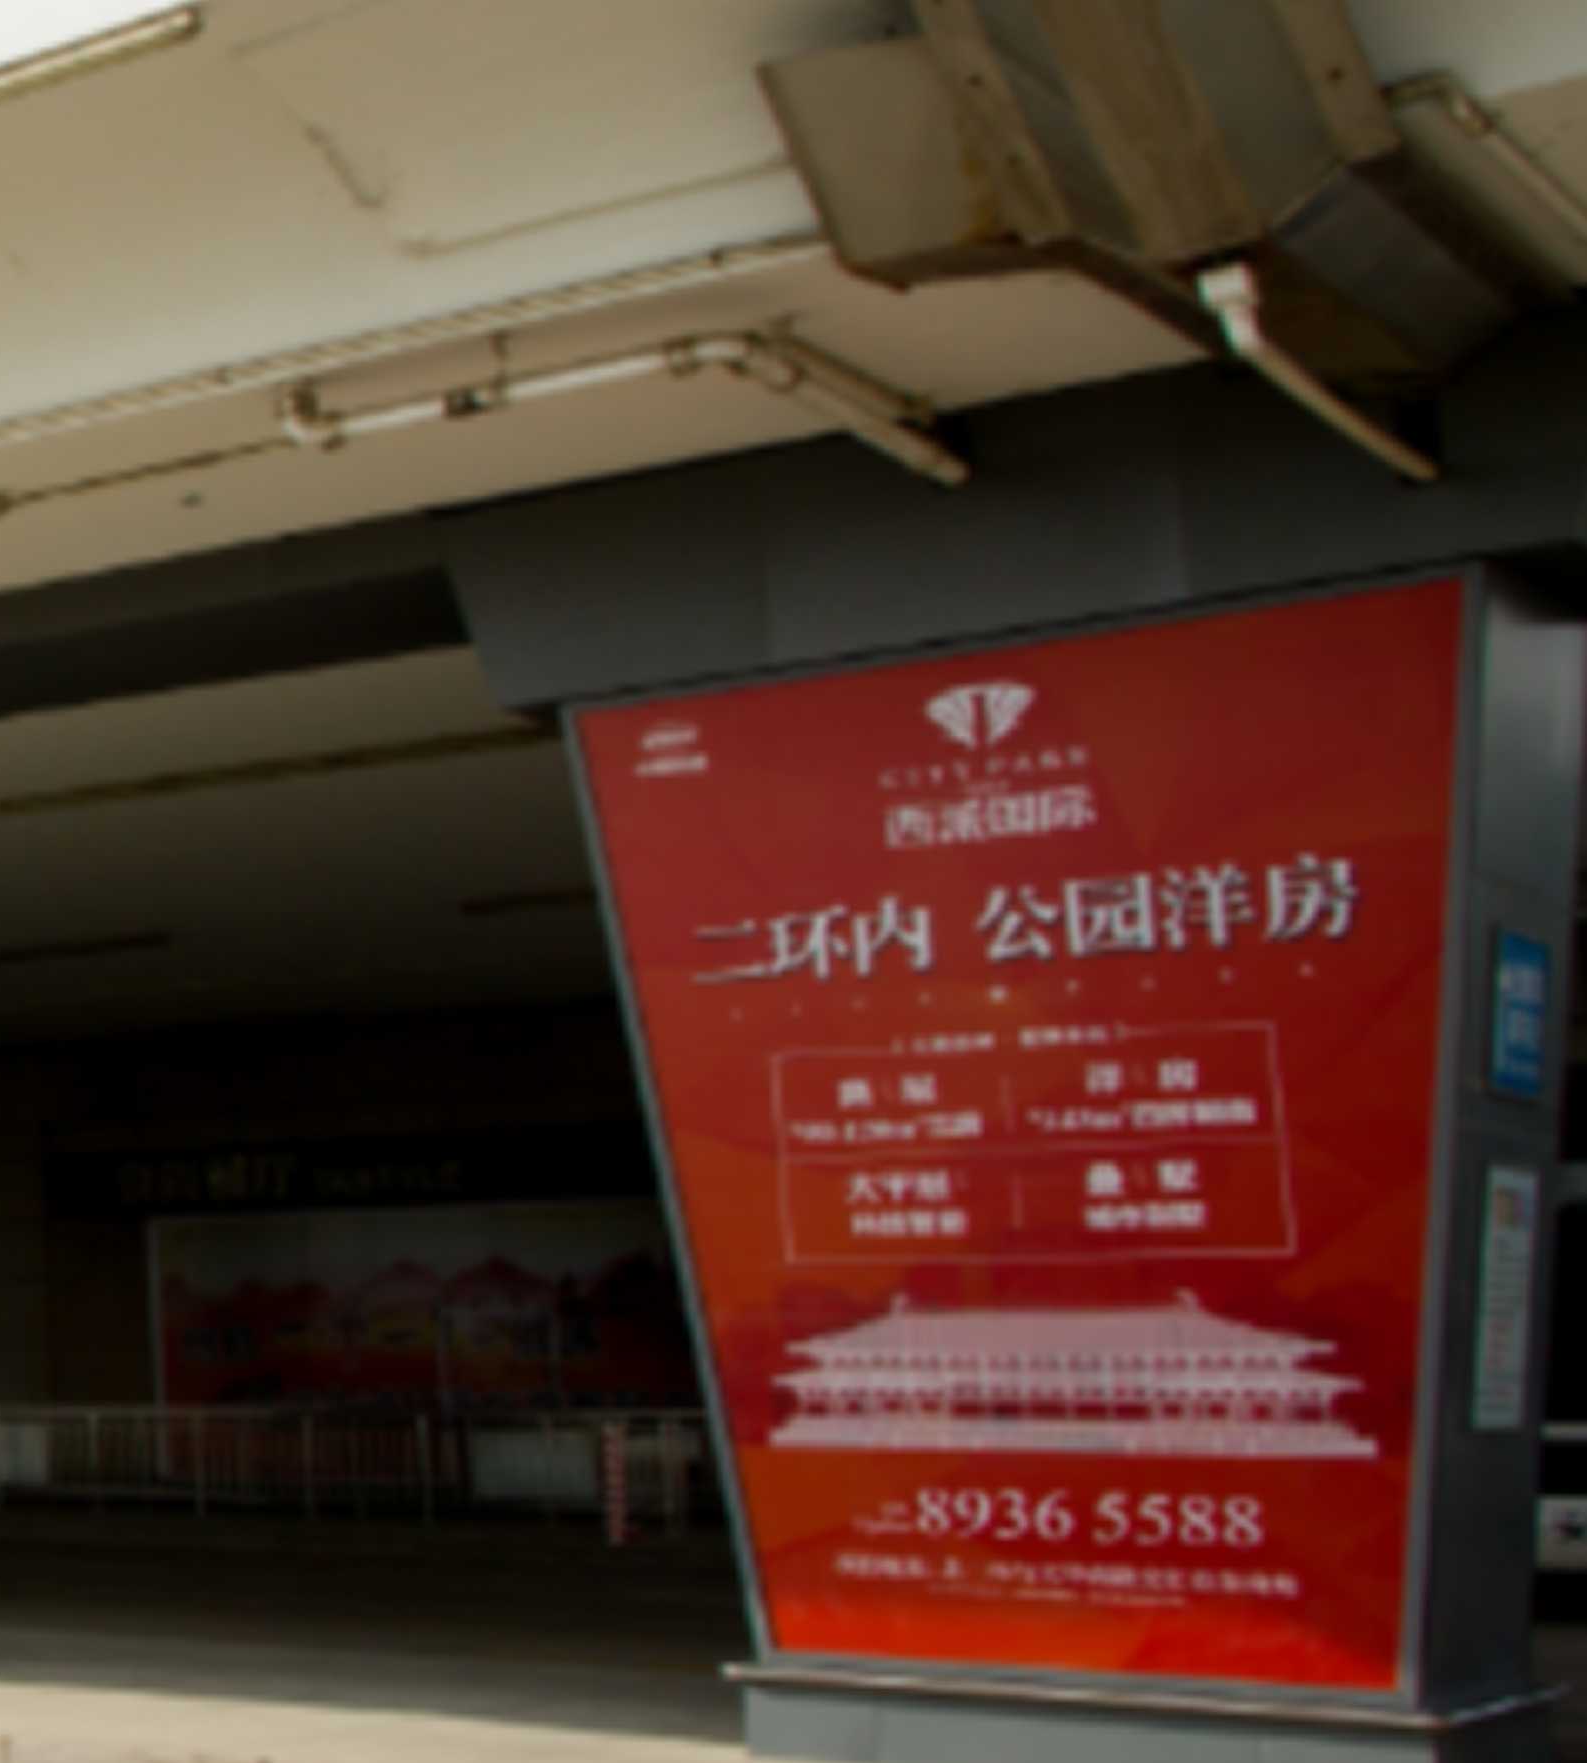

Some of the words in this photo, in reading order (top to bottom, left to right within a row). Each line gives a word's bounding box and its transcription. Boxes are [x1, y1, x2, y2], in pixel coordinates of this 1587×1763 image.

[691, 894, 932, 983] 二环内
[975, 852, 1357, 964] 公园洋房
[914, 1486, 1074, 1542] 8936
[1091, 1488, 1266, 1549] 5588
